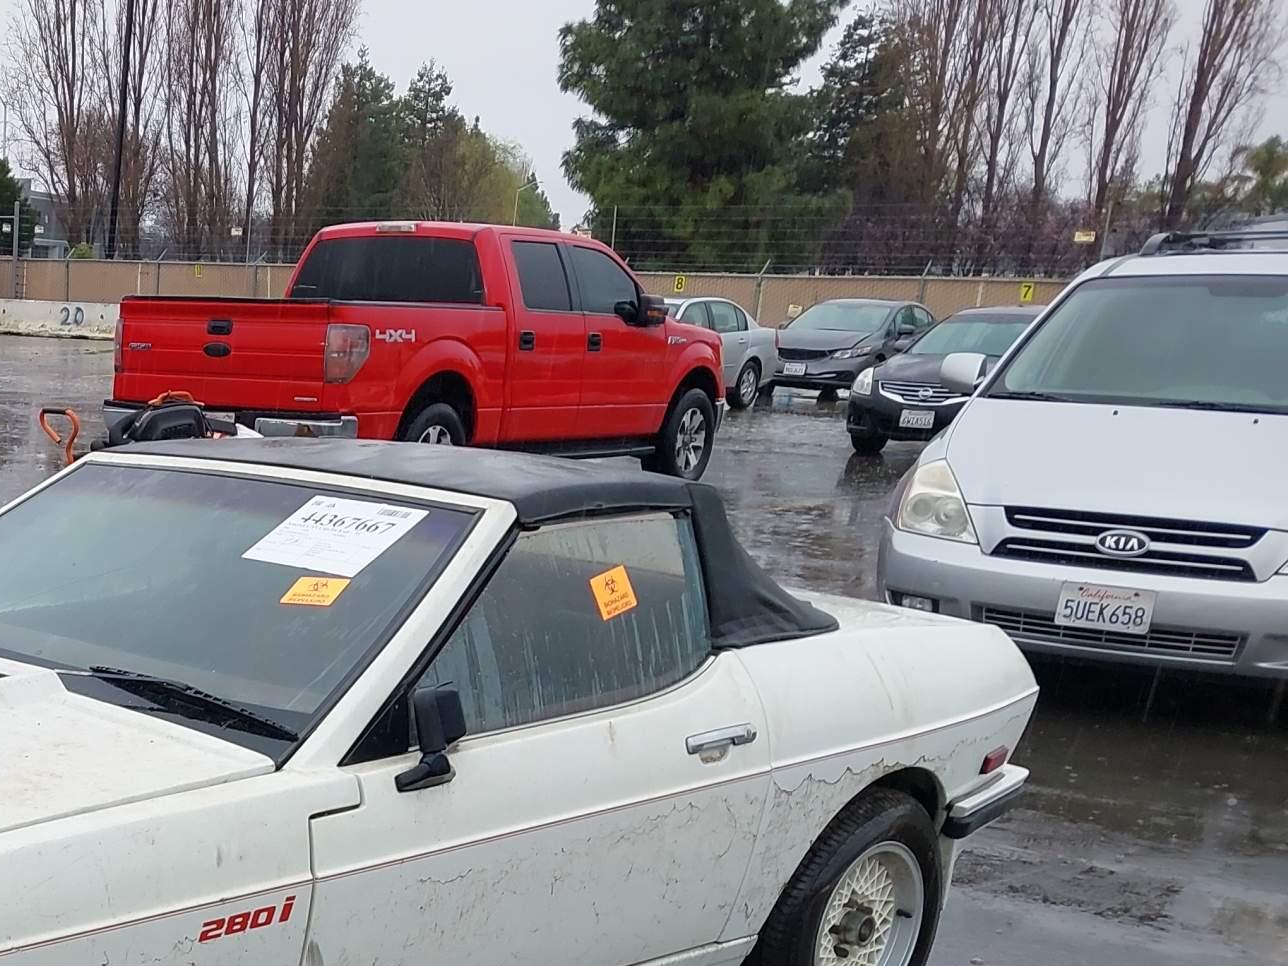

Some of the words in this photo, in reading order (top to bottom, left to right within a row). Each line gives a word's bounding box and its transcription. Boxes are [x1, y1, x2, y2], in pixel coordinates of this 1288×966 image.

[676, 277, 684, 290] 8
[1023, 284, 1032, 299] 7
[59, 306, 85, 326] 20
[300, 511, 396, 534] 44367667
[1104, 535, 1140, 551] KIA
[1080, 587, 1133, 602] California
[1063, 599, 1146, 626] 5UEK658
